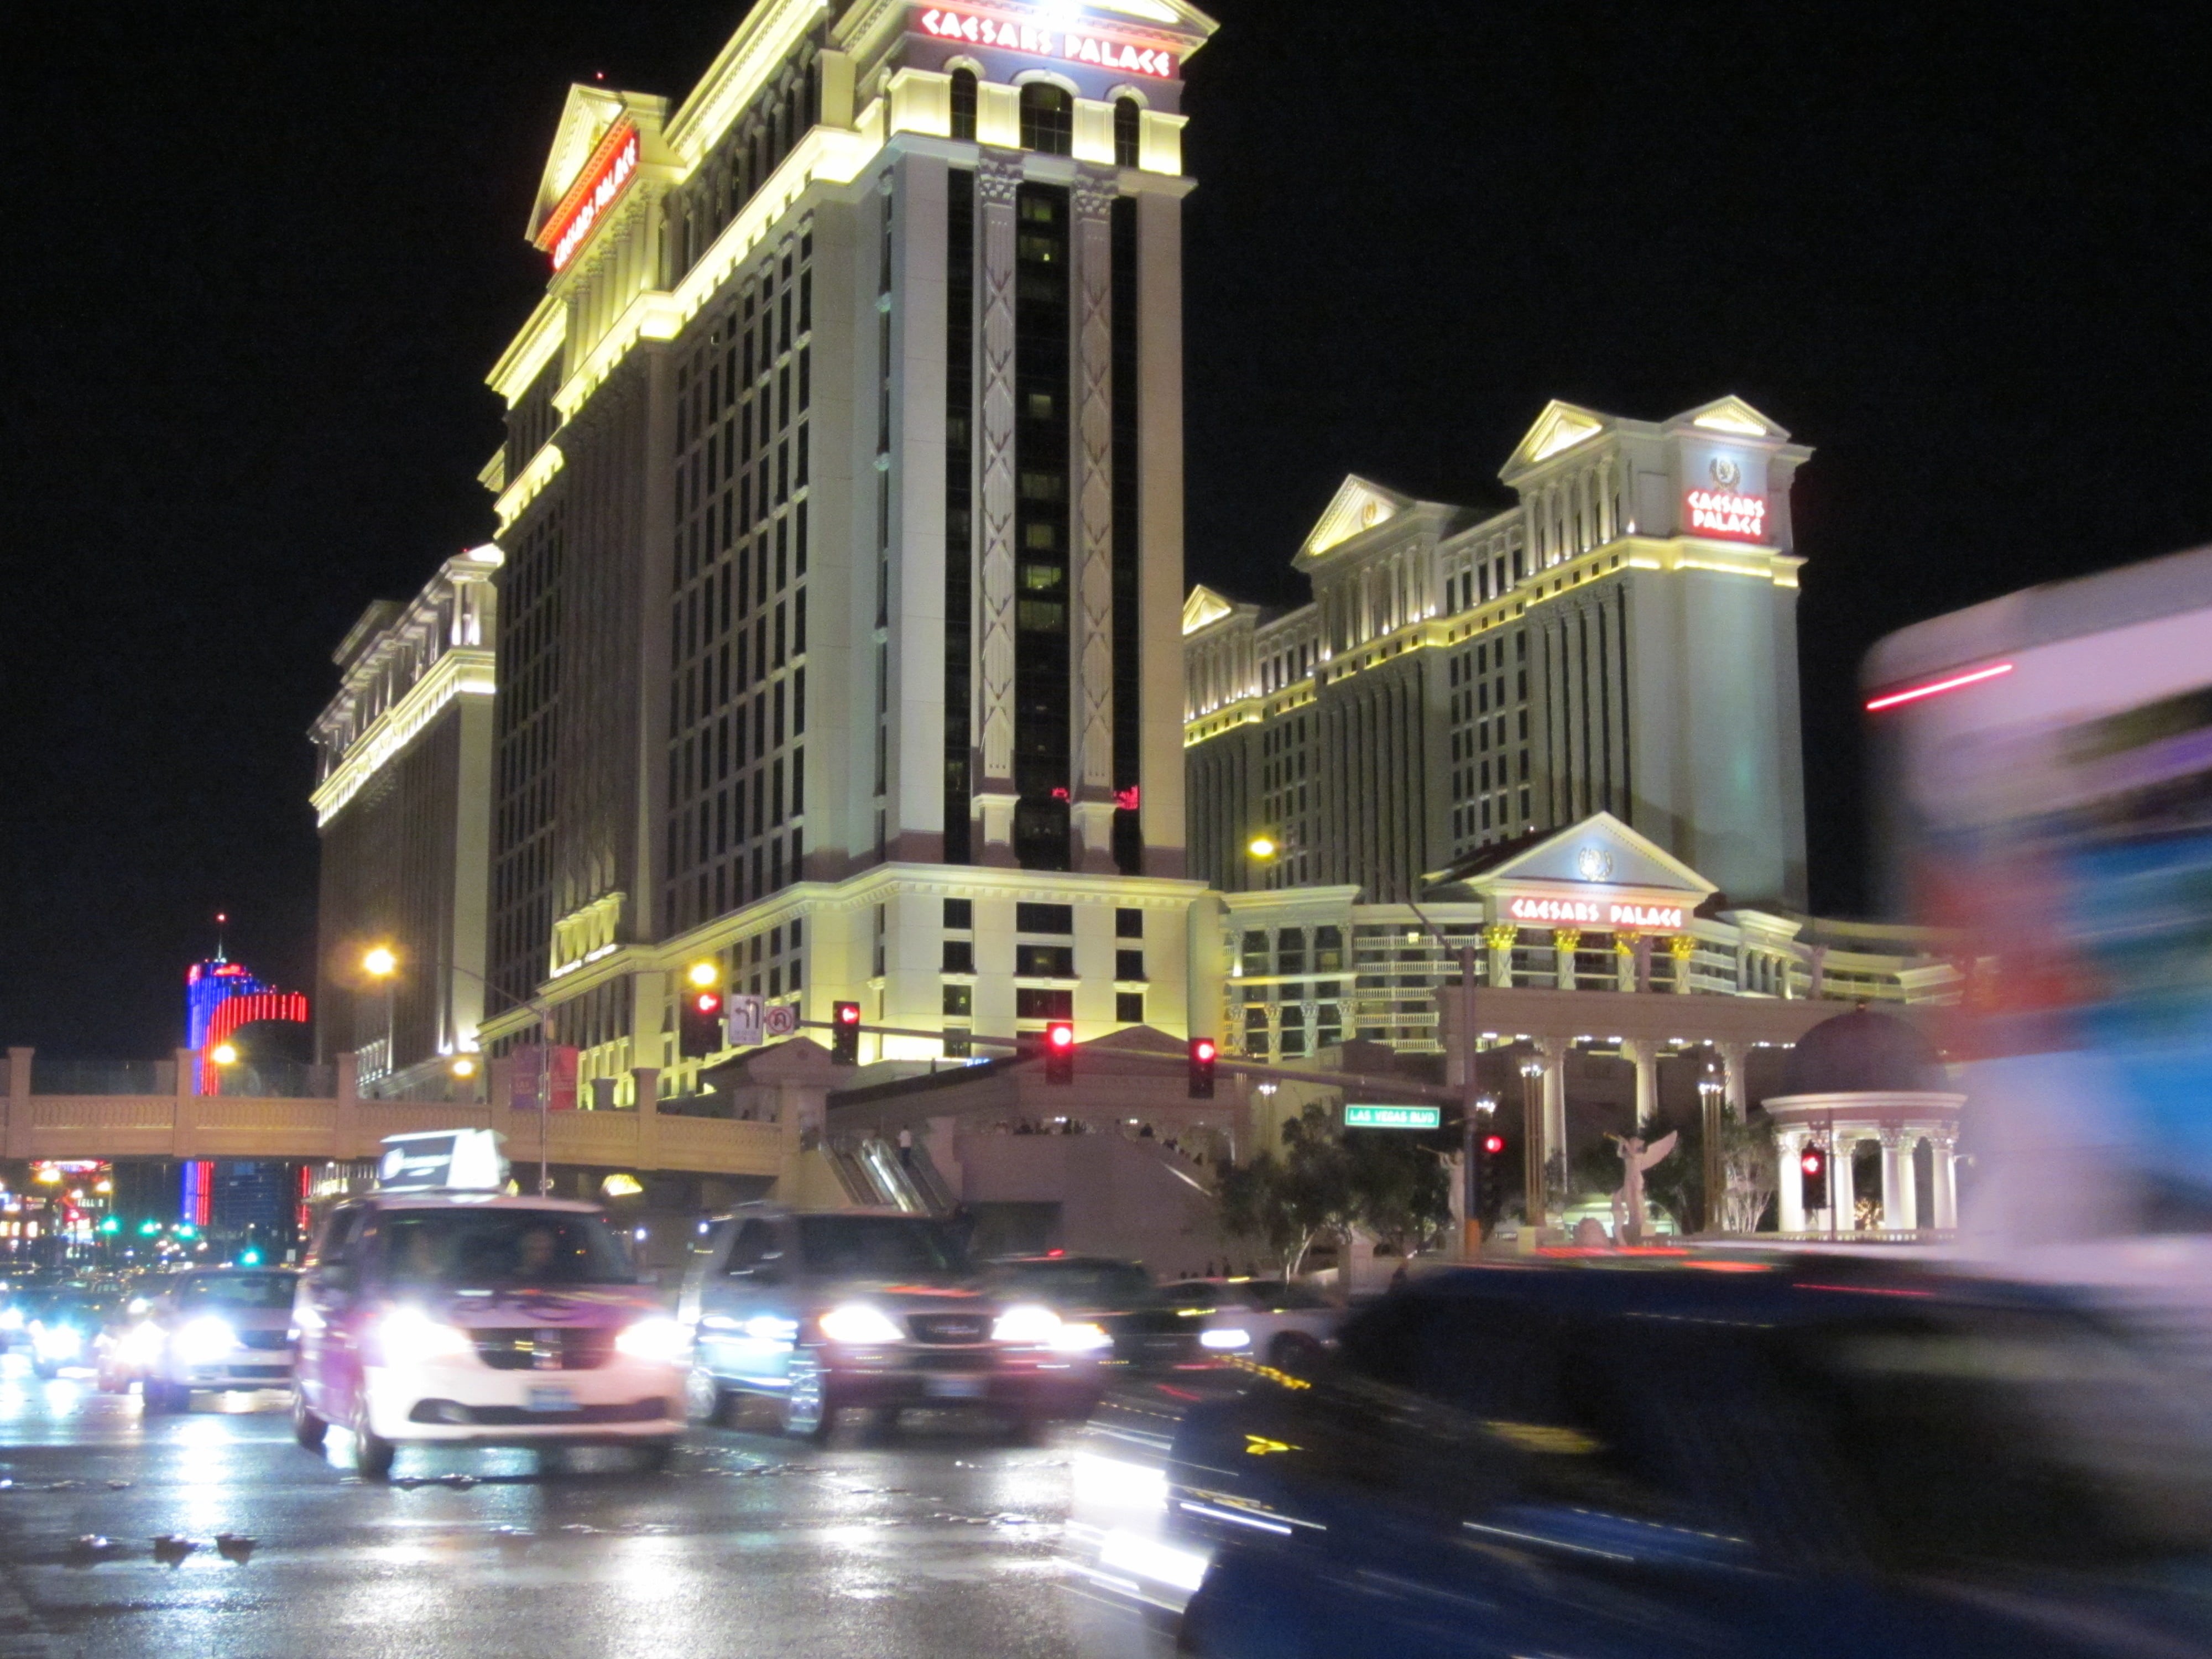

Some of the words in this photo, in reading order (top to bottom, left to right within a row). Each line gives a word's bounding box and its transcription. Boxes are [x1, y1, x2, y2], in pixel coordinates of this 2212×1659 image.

[922, 9, 1053, 54] CAESARS
[1065, 34, 1170, 77] PALACE
[1688, 491, 1765, 518] CAESARS
[1693, 509, 1761, 535] PALACE
[1511, 899, 1599, 922] CAESARS
[1610, 905, 1682, 926] PALACE
[1350, 1110, 1371, 1121] LAS
[1375, 1110, 1407, 1123] VEGAS
[1410, 1111, 1435, 1123] BLVD
